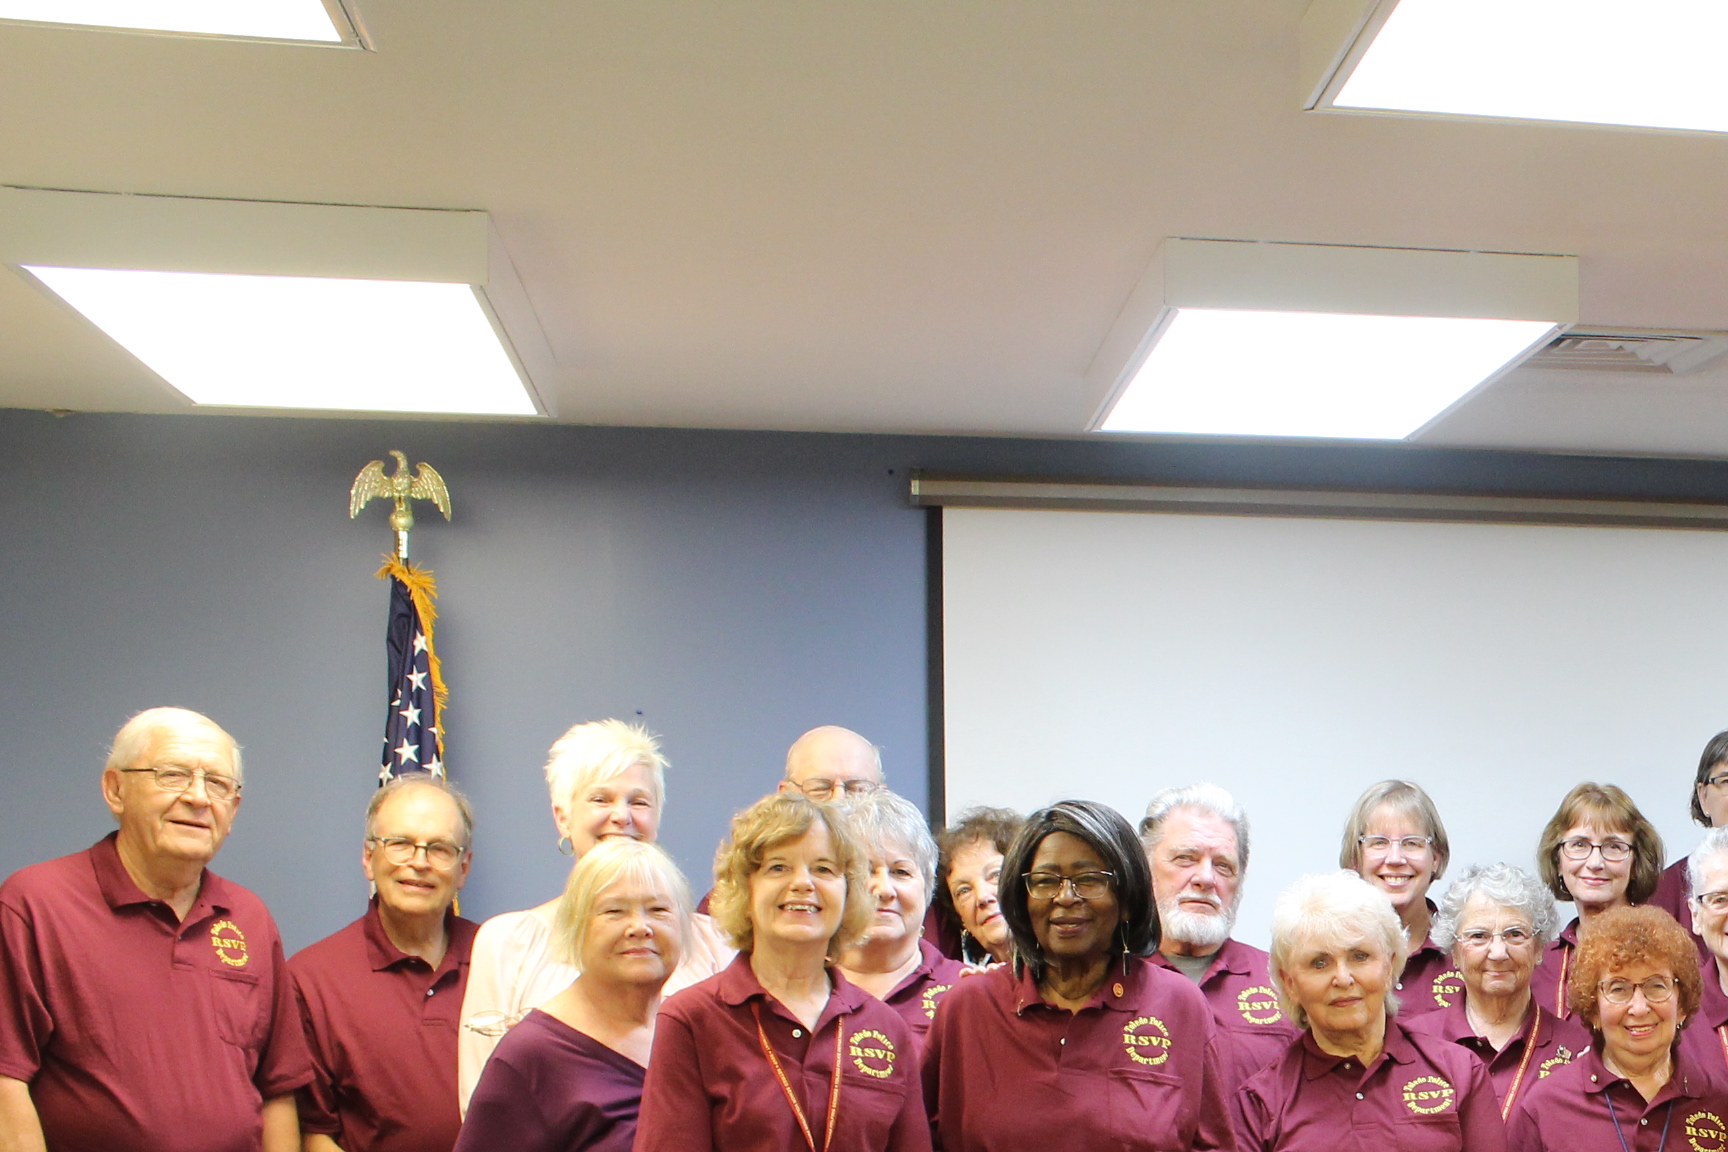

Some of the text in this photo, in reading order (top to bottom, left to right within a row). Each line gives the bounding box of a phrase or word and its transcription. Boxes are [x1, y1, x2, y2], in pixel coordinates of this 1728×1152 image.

[1432, 984, 1461, 994] RSV
[1123, 1016, 1170, 1037] Toledo Police
[1123, 1033, 1172, 1050] RSVP
[849, 1045, 896, 1063] RSVP
[1125, 1046, 1170, 1066] Department
[1403, 1075, 1450, 1092] Toledo Police
[1402, 1088, 1455, 1102] RSVP
[1406, 1098, 1453, 1115] Department
[1685, 1125, 1728, 1143] RSVP
